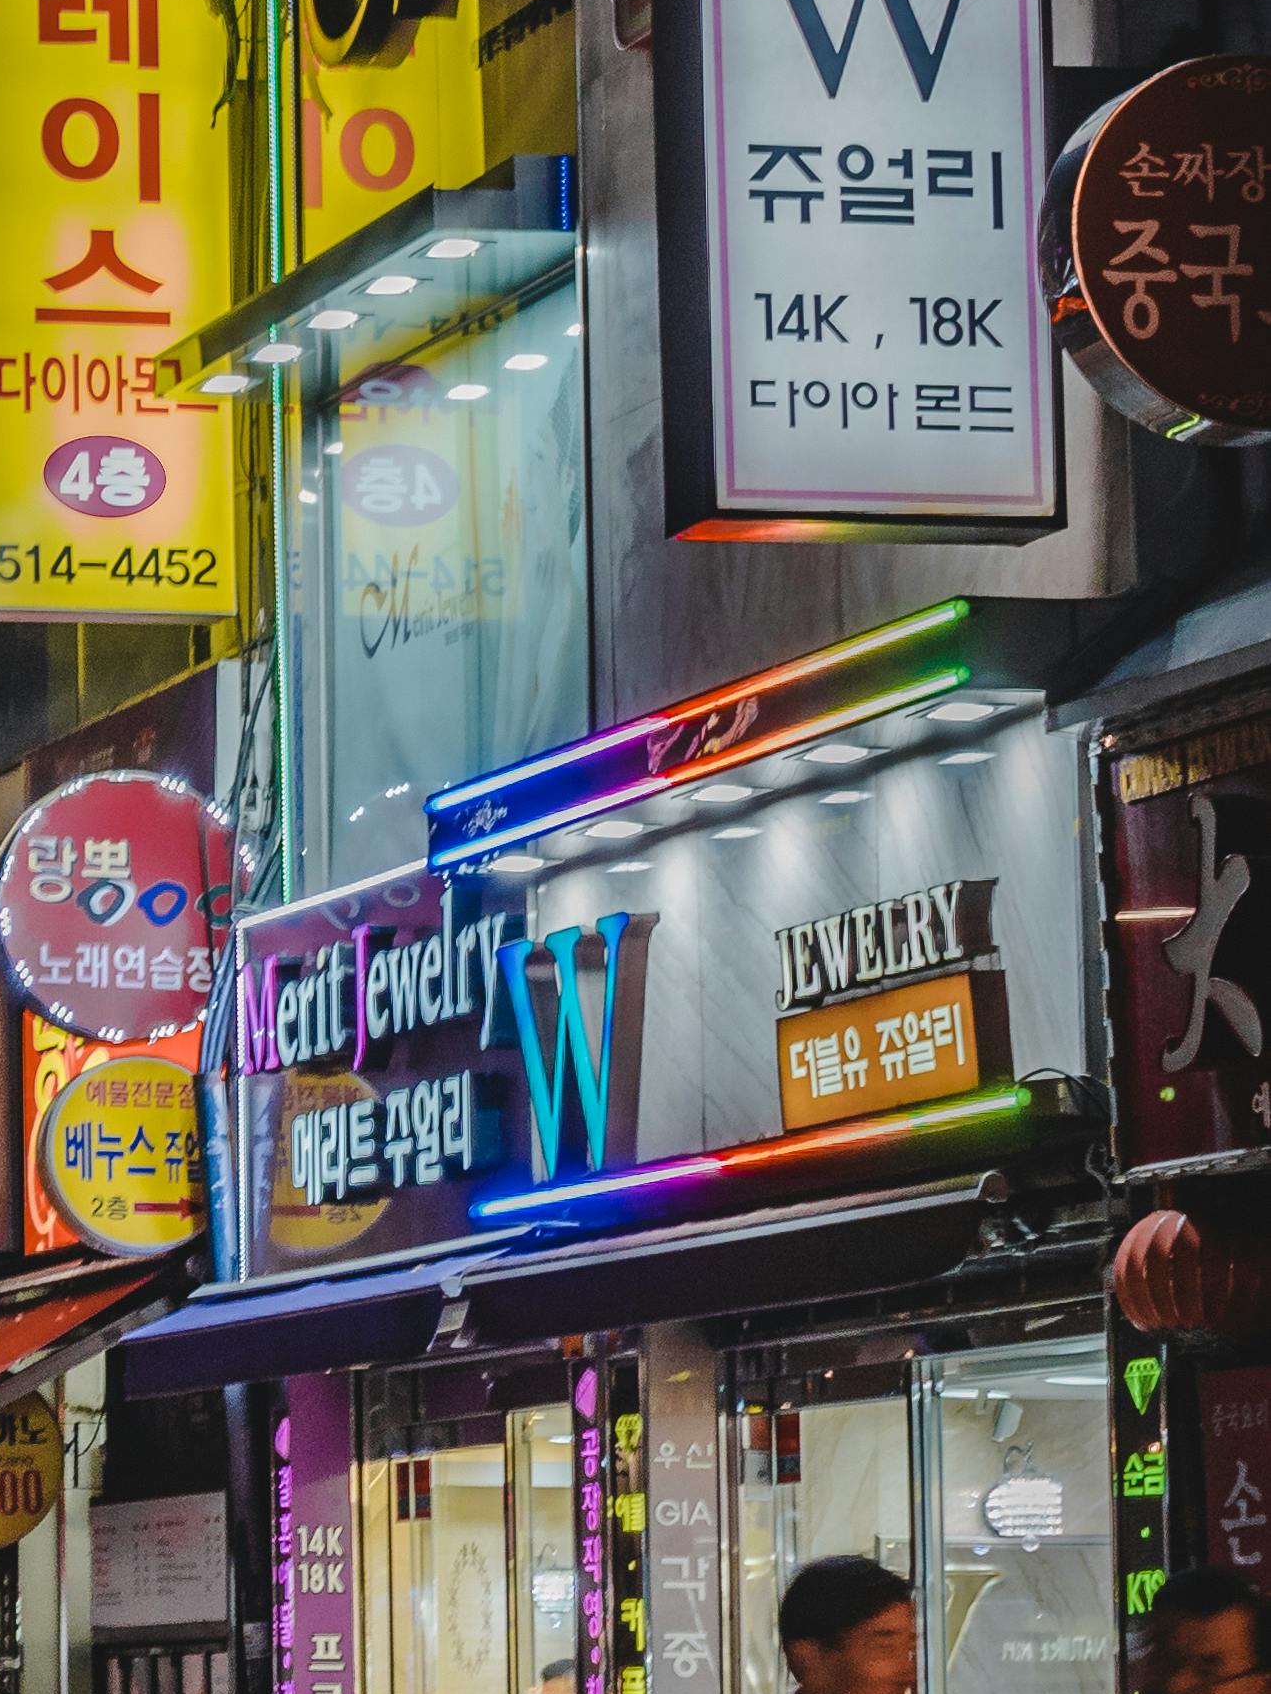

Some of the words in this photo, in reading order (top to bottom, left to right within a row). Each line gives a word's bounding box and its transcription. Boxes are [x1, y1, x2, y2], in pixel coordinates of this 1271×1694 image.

[748, 142, 1005, 231] 쥬얼리
[1102, 218, 1271, 345] 중국
[754, 292, 851, 345] 14K
[909, 296, 1006, 350] 18K
[59, 447, 151, 507] 4층
[38, 943, 219, 994] 노래연습장
[242, 941, 346, 1076] Merit
[350, 887, 507, 1072] Jewelry
[774, 879, 966, 1011] JEWELRY
[496, 911, 631, 1184] W
[788, 1028, 870, 1101] 더블유
[875, 1002, 968, 1077] 쥬얼리
[64, 1119, 156, 1181] 베누스
[290, 1098, 379, 1206] 메리트
[383, 1068, 472, 1190] 주얼리
[90, 1195, 130, 1220] 2층
[296, 1524, 344, 1557] 14K
[580, 1427, 604, 1640] 공장직영
[654, 1498, 713, 1527] GIA
[297, 1560, 346, 1594] 18K
